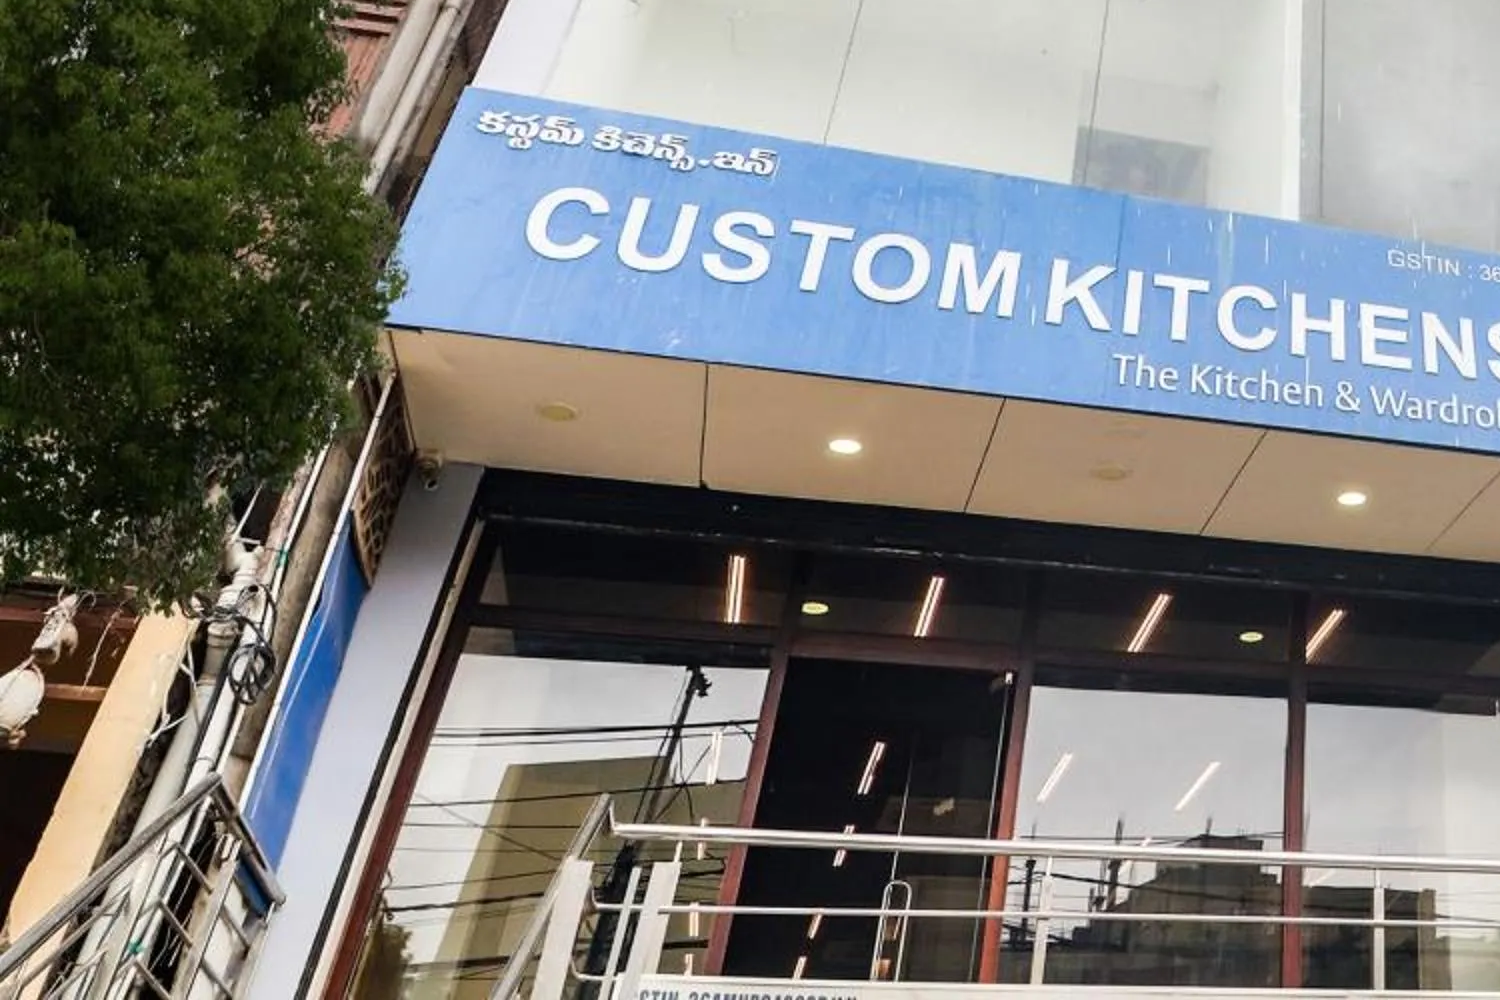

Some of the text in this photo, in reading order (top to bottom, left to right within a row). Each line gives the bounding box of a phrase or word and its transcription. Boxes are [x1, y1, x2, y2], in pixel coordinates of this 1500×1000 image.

[525, 186, 1022, 319] CUSTOM
[1386, 248, 1461, 277] GSTIN
[1112, 353, 1179, 392] The
[1190, 362, 1323, 408] Kitchen
[1335, 380, 1361, 413] &
